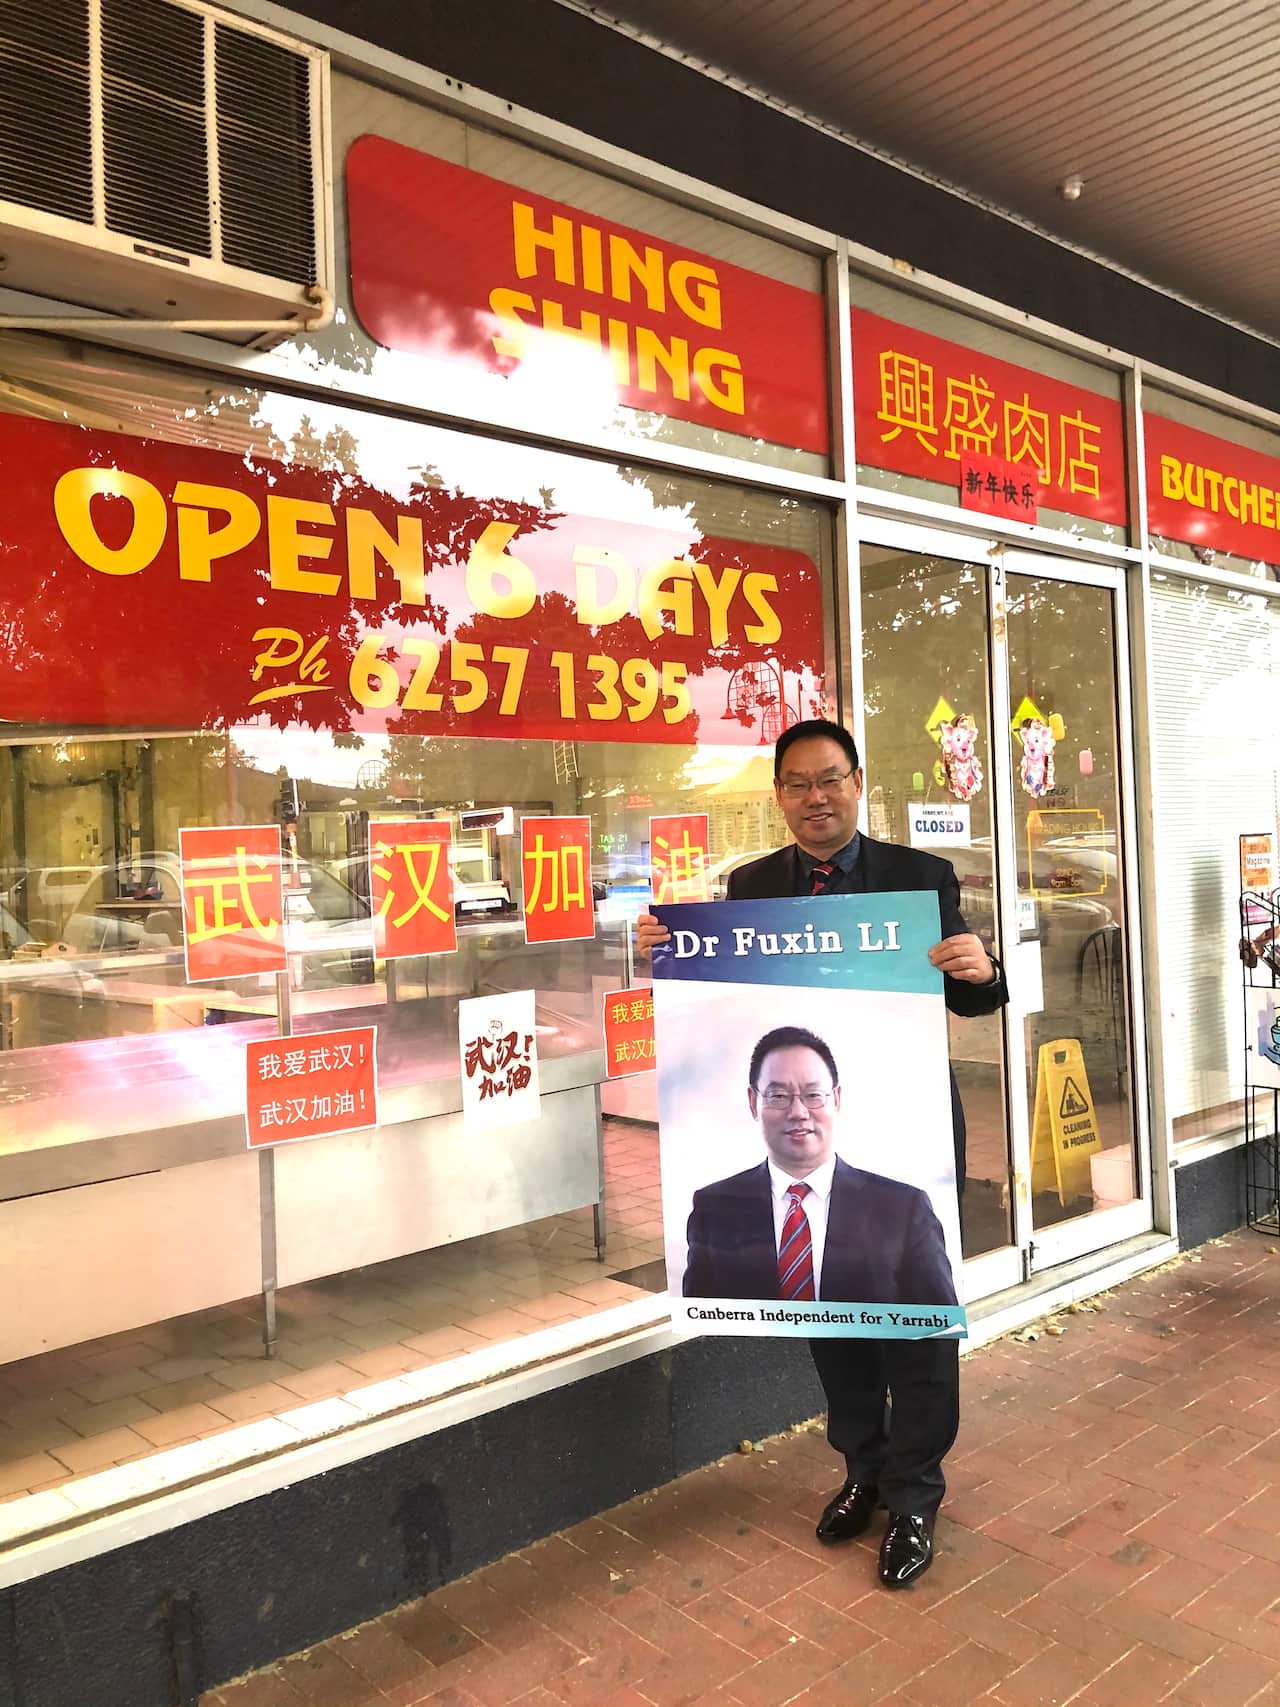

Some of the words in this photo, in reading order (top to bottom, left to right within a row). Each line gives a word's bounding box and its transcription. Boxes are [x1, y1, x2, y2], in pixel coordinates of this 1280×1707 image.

[512, 200, 722, 331] HING
[877, 350, 1101, 500] 興盛肉店
[964, 467, 1034, 509] 新年快乐
[1161, 454, 1280, 531] BUTCHE
[54, 467, 427, 606] OPEN
[466, 521, 537, 619] 6
[572, 543, 783, 648] DAYS
[993, 566, 1002, 586] 2
[248, 627, 331, 682] Ph
[348, 634, 529, 717] 6257
[551, 651, 691, 725] 1395
[915, 819, 964, 833] CLOSED
[184, 847, 279, 945] 武
[372, 840, 451, 930] 汉
[524, 834, 586, 914] 加
[652, 830, 706, 904] 油
[673, 930, 720, 959] Dr
[732, 924, 843, 957] Fuxin
[857, 921, 902, 952] LI
[258, 1043, 368, 1081] 我爱武汉！
[464, 1031, 535, 1078] 武汉!
[478, 1064, 532, 1102] 加油
[259, 1089, 366, 1129] 武汉加油！
[686, 1306, 755, 1321] Canberra
[760, 1308, 856, 1325] Independent
[860, 1311, 883, 1324] for
[888, 1313, 949, 1328] Yarrabi
